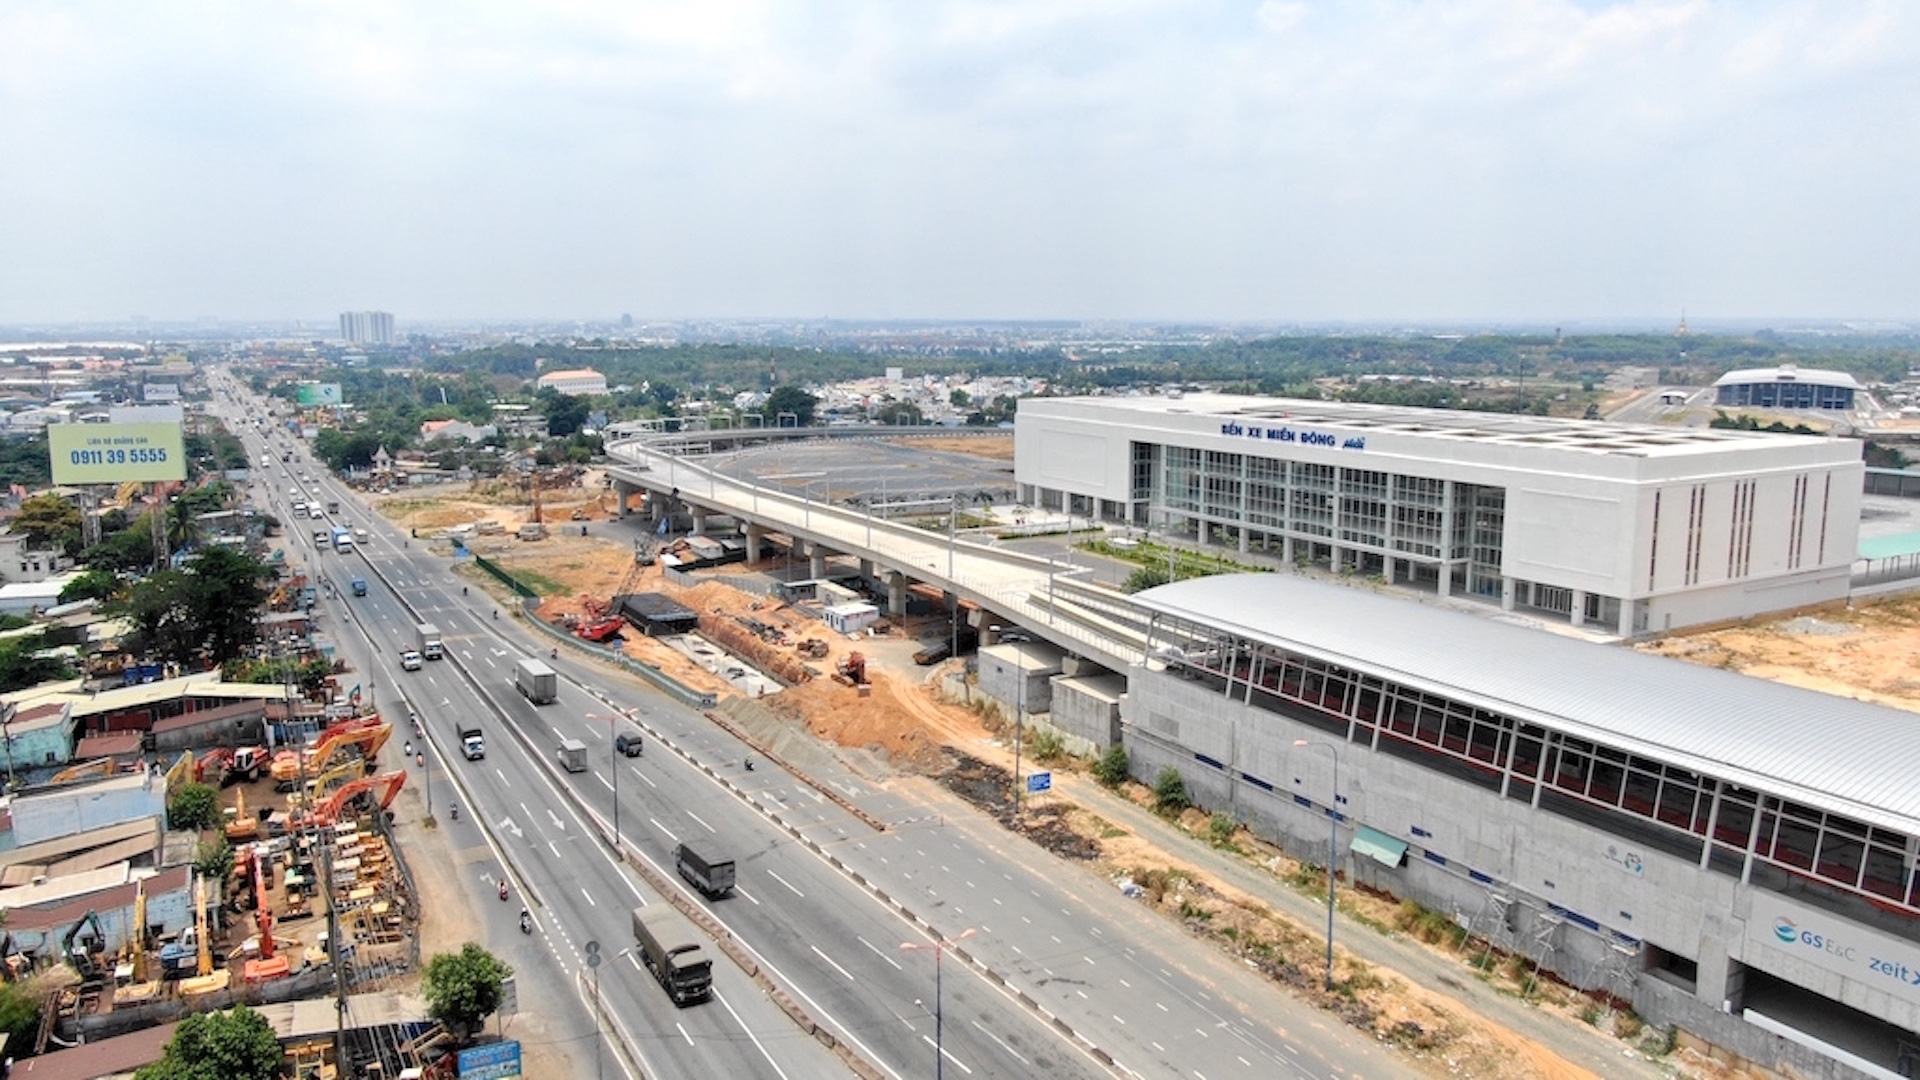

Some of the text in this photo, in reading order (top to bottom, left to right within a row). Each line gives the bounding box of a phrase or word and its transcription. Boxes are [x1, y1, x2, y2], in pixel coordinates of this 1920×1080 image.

[1222, 420, 1243, 435] BẾN
[1248, 427, 1262, 438] XE
[1301, 431, 1336, 446] ĐÔNG
[71, 448, 166, 464] 0911 39 5555
[1802, 931, 1855, 962] GS E&C
[1869, 957, 1909, 982] zeit
